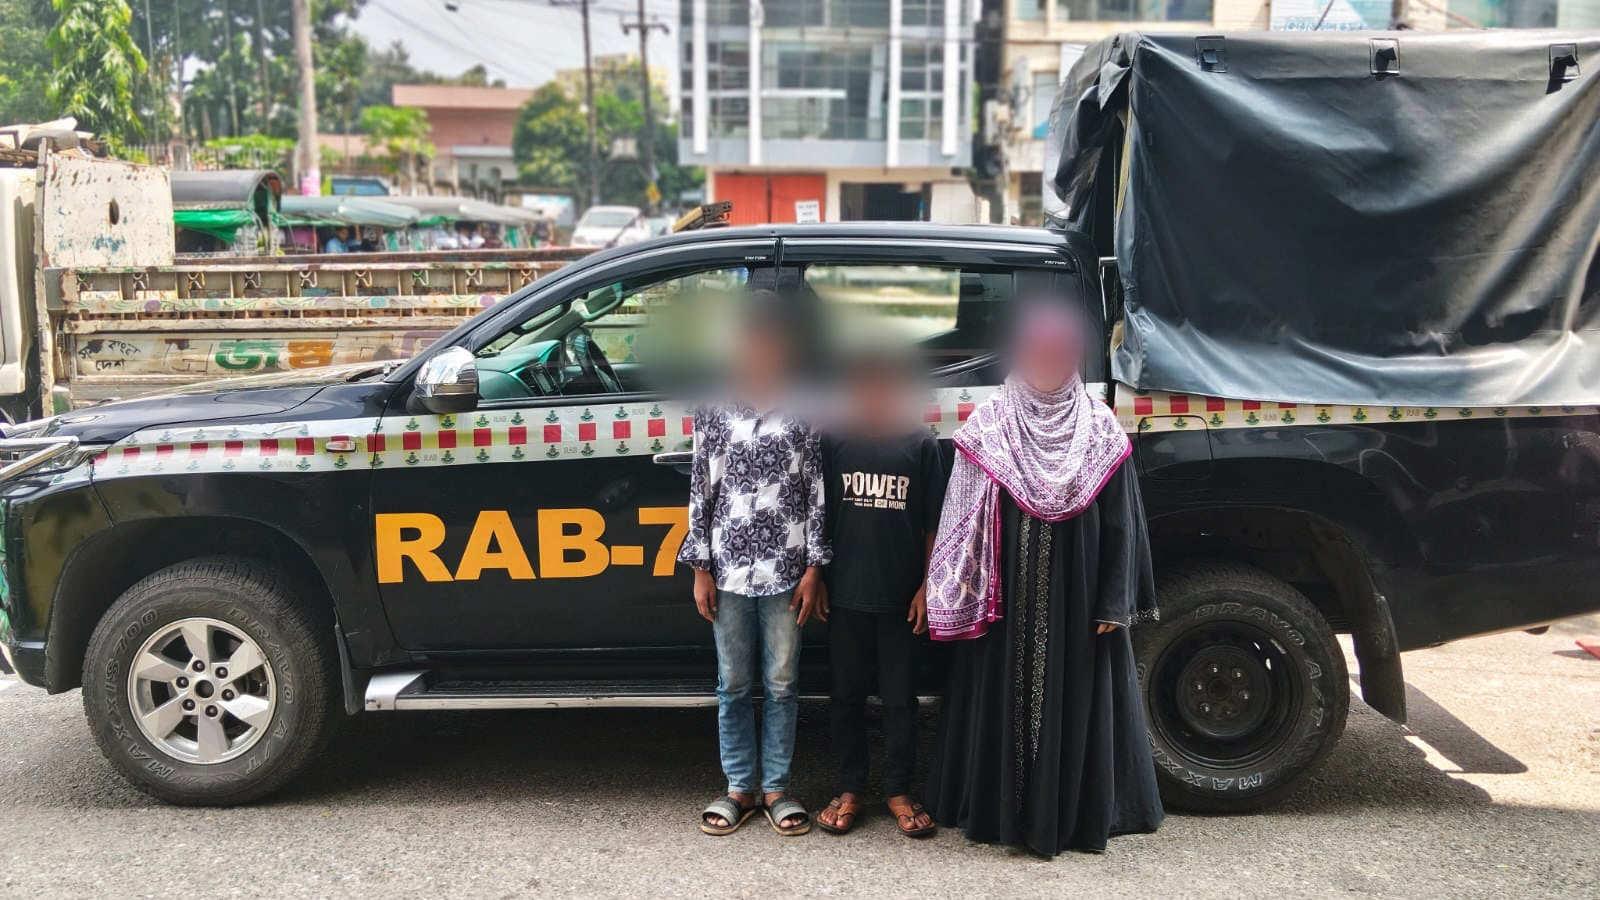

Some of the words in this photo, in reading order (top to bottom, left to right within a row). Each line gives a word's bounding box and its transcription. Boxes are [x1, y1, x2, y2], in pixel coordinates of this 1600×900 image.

[841, 471, 910, 500] POWER
[375, 506, 691, 584] RAB-7
[113, 607, 160, 656] 700
[1194, 601, 1306, 647] BRAVO
[226, 607, 296, 706] BRAVO
[104, 658, 176, 780] MAXXIS
